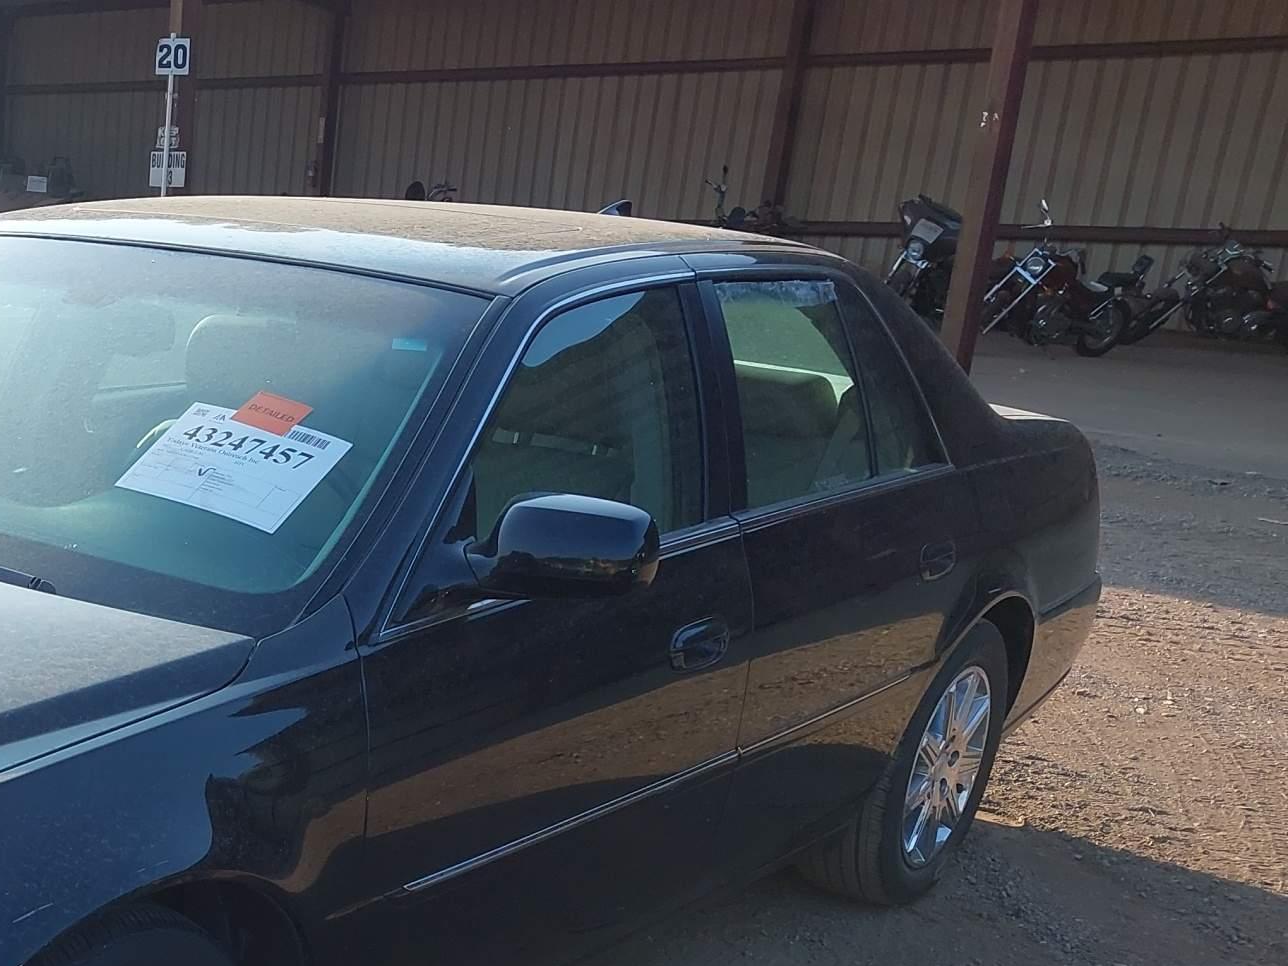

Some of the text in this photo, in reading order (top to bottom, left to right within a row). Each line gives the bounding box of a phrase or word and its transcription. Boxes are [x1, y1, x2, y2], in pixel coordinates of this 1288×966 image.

[159, 44, 187, 69] 20
[152, 153, 185, 168] BUIDING
[248, 403, 295, 422] DETAILED
[183, 425, 315, 469] 43247457
